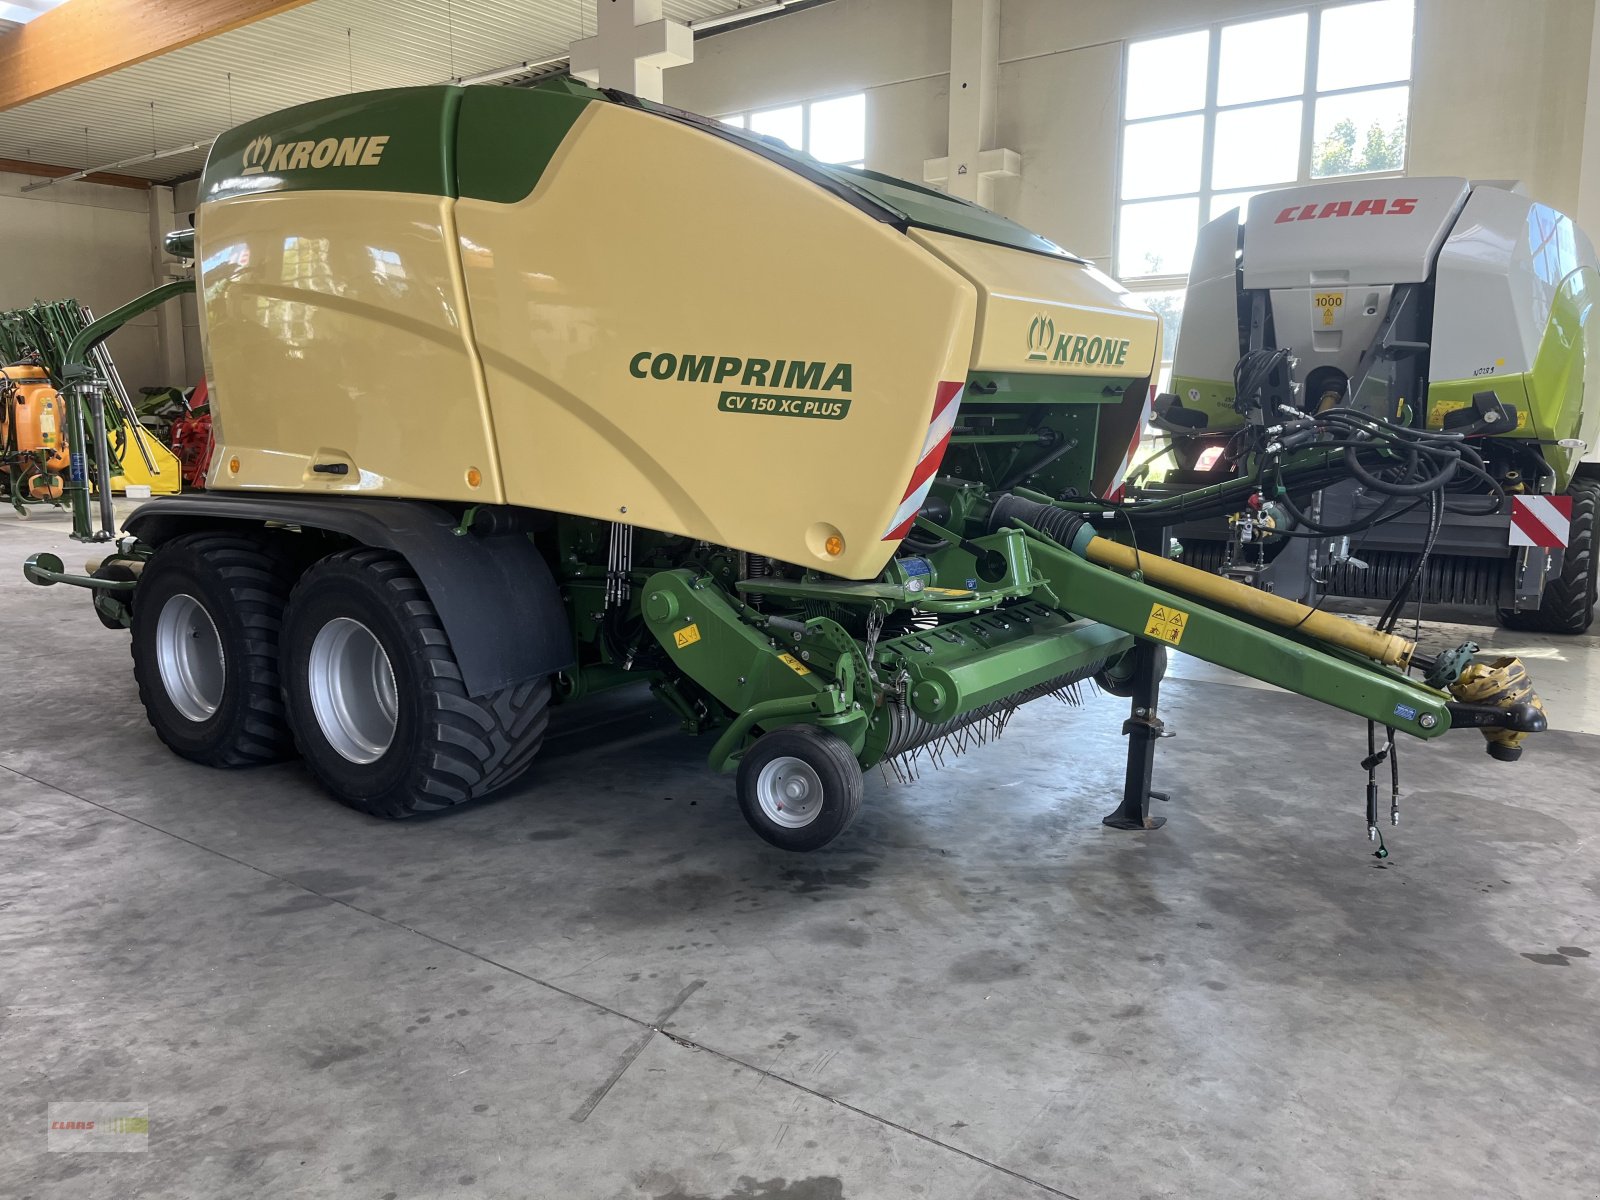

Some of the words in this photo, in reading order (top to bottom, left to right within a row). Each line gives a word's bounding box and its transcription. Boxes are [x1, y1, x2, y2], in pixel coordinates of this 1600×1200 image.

[268, 135, 390, 172] KRONE
[1274, 198, 1419, 224] CLAAS
[1316, 297, 1342, 307] 1000
[1052, 333, 1130, 366] KRONE
[629, 351, 852, 392] COMPRIMA
[725, 396, 747, 409] CV
[751, 397, 776, 411] 150
[779, 399, 802, 413] XC
[803, 402, 842, 416] PLUS
